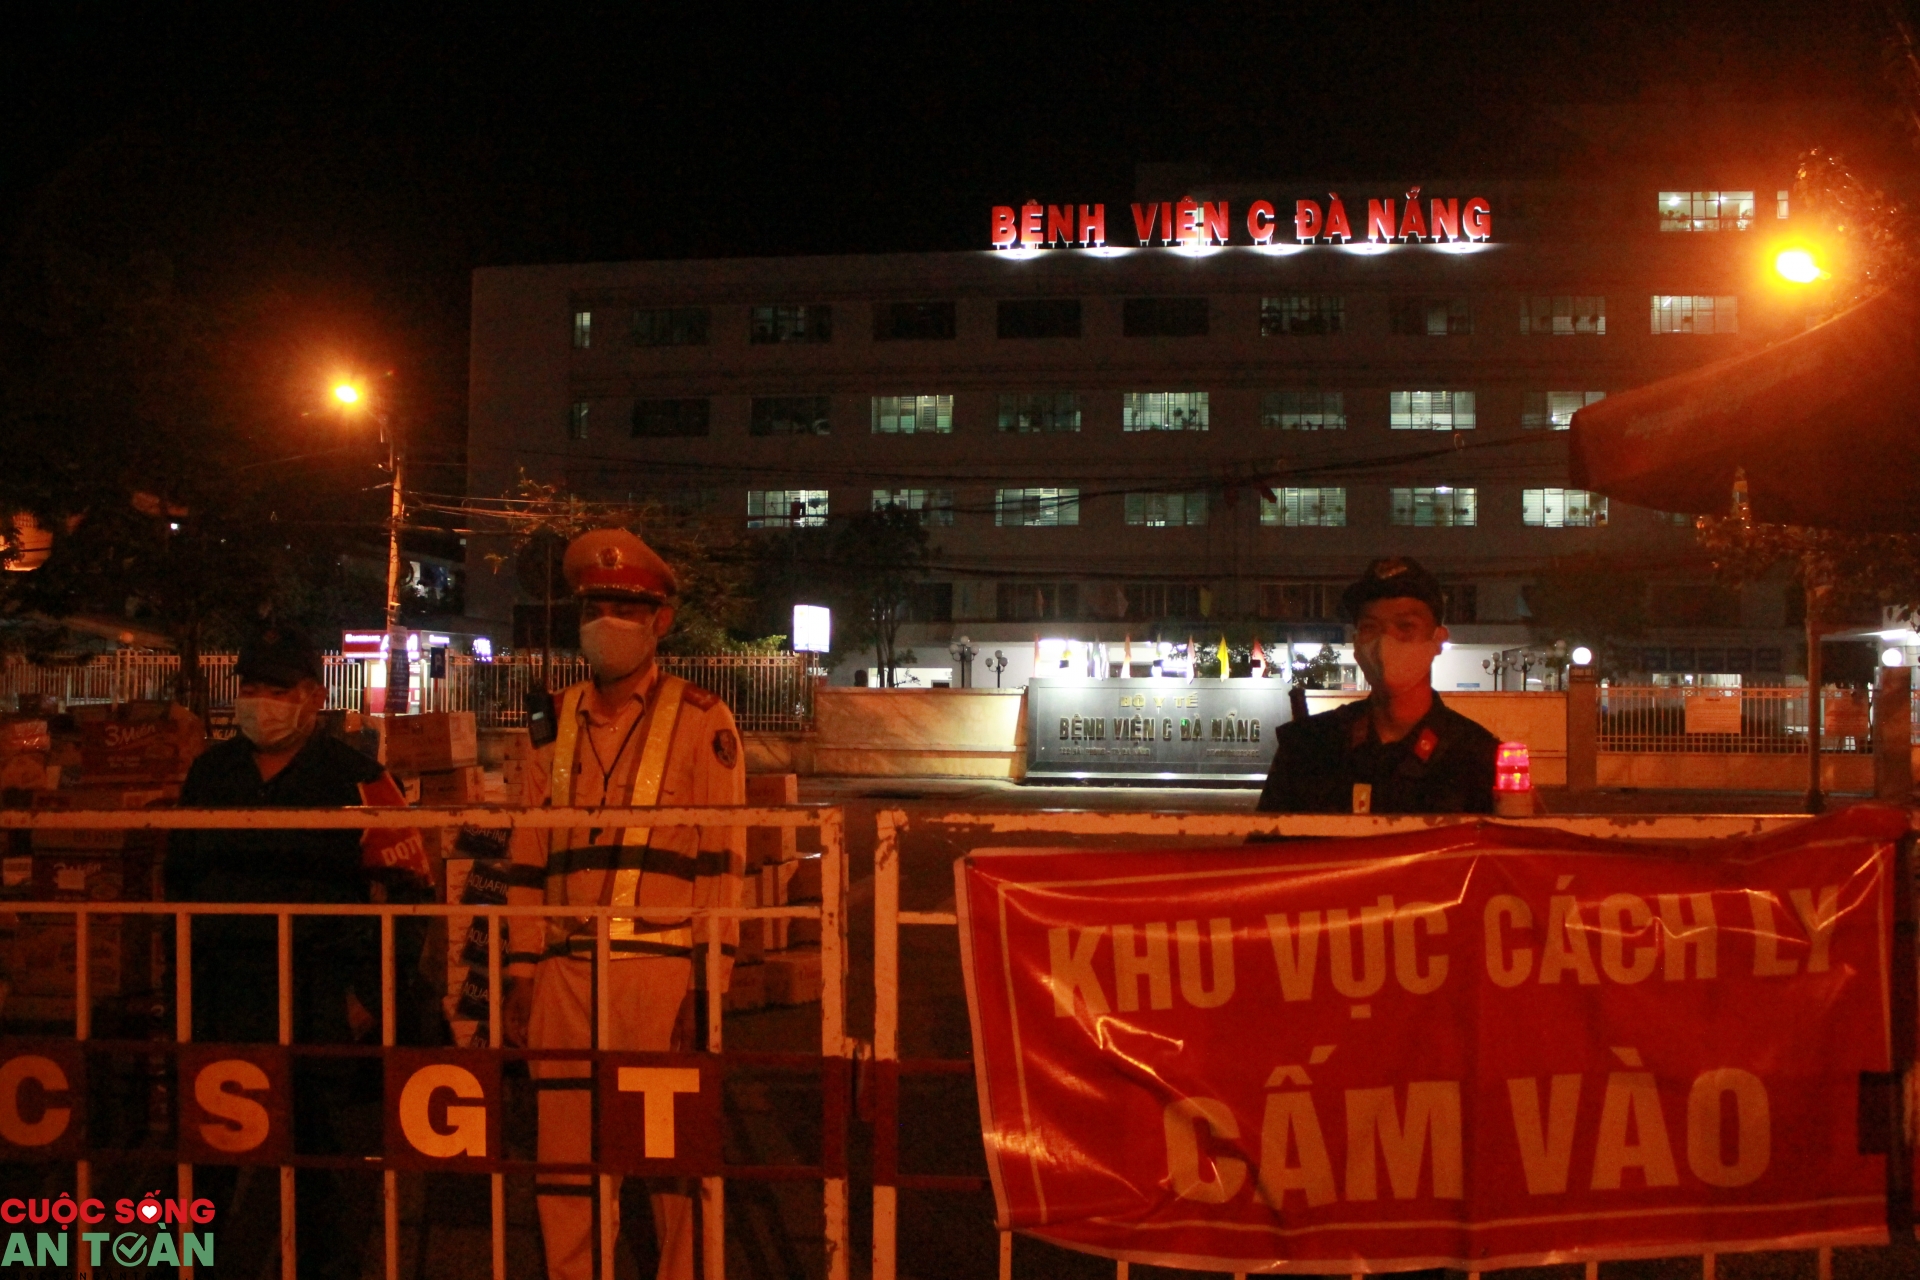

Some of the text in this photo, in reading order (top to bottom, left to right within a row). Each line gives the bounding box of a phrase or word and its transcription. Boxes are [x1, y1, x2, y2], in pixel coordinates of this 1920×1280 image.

[1247, 199, 1275, 239] C
[1294, 192, 1352, 240] ĐÀ
[1121, 693, 1145, 710] BỘ
[1154, 697, 1166, 708] Y
[1059, 714, 1106, 745] BỆNH
[1114, 713, 1155, 745] VIỆN
[1162, 718, 1172, 742] C
[1180, 713, 1204, 742] ĐÀ
[1048, 875, 1840, 1019] KHU VỰC CÁCH LY
[1163, 1044, 1771, 1210] CẤM VÀO
